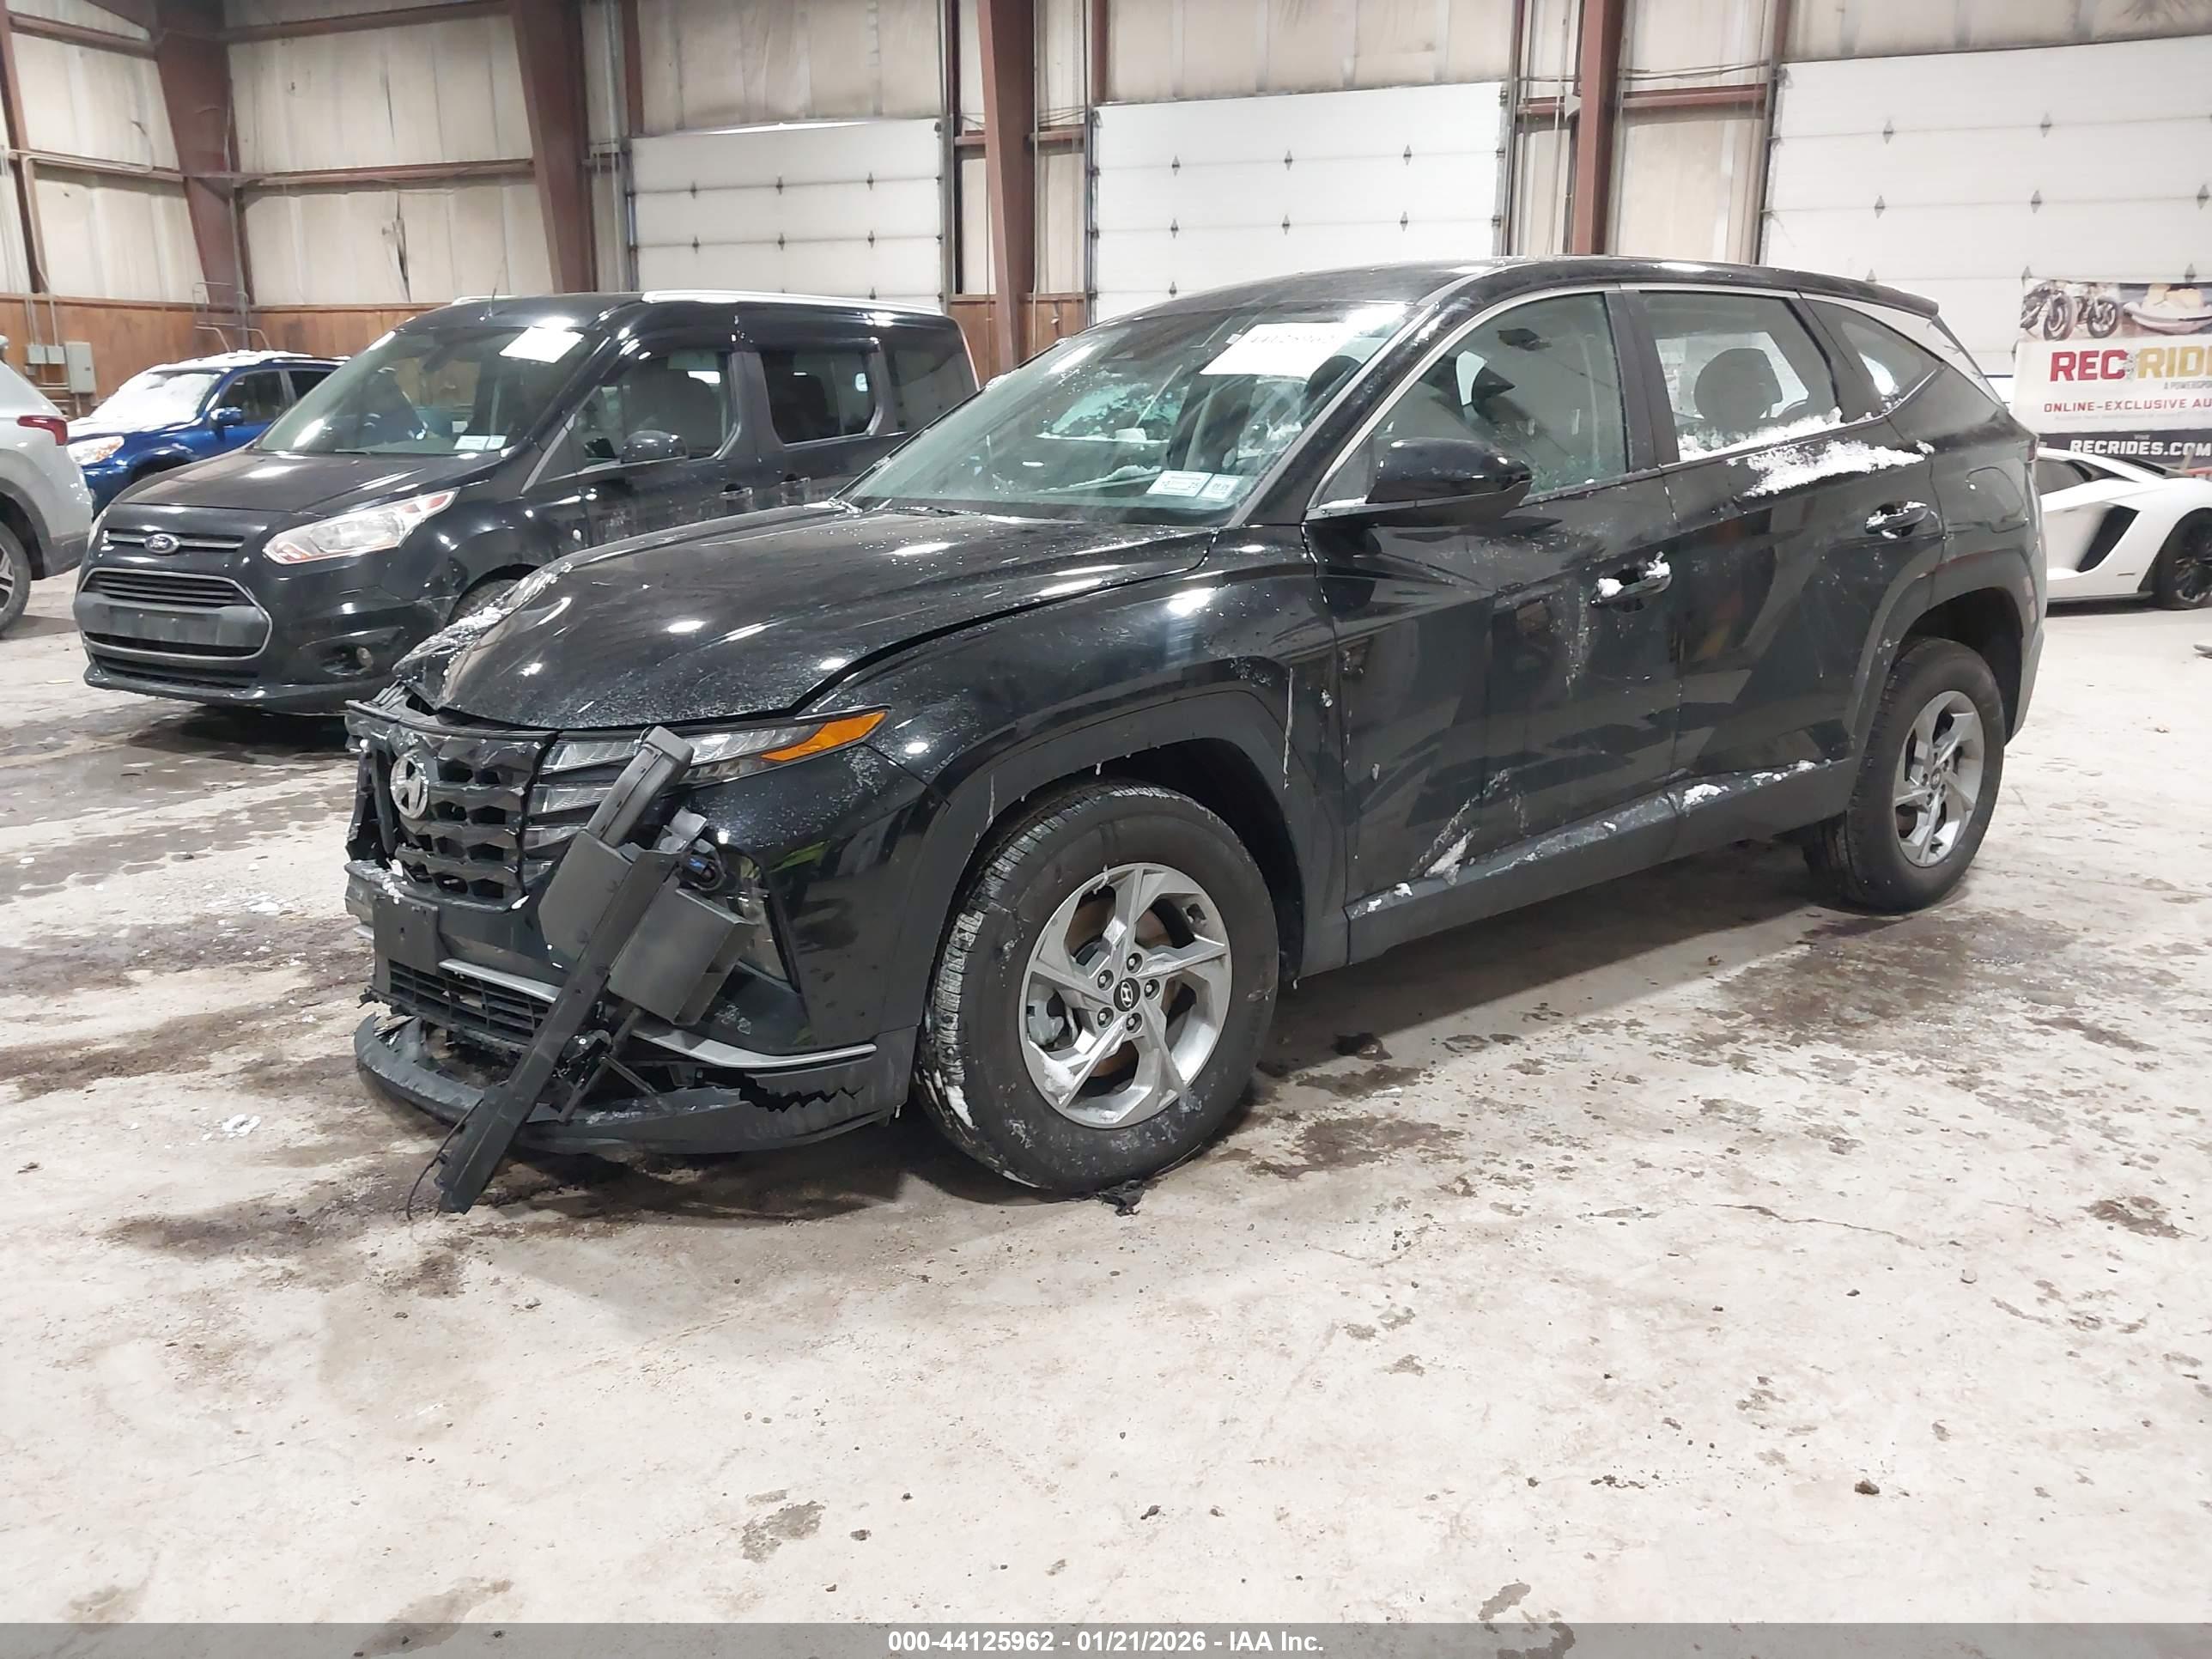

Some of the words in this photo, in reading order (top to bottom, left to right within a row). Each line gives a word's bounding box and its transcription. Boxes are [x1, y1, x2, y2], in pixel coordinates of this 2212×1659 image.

[2050, 349, 2129, 382] REC
[2136, 345, 2212, 379] RID
[2044, 398, 2187, 413] ONLINE-EXCLUSIVE
[2069, 439, 2211, 456] RECRIDES.COM
